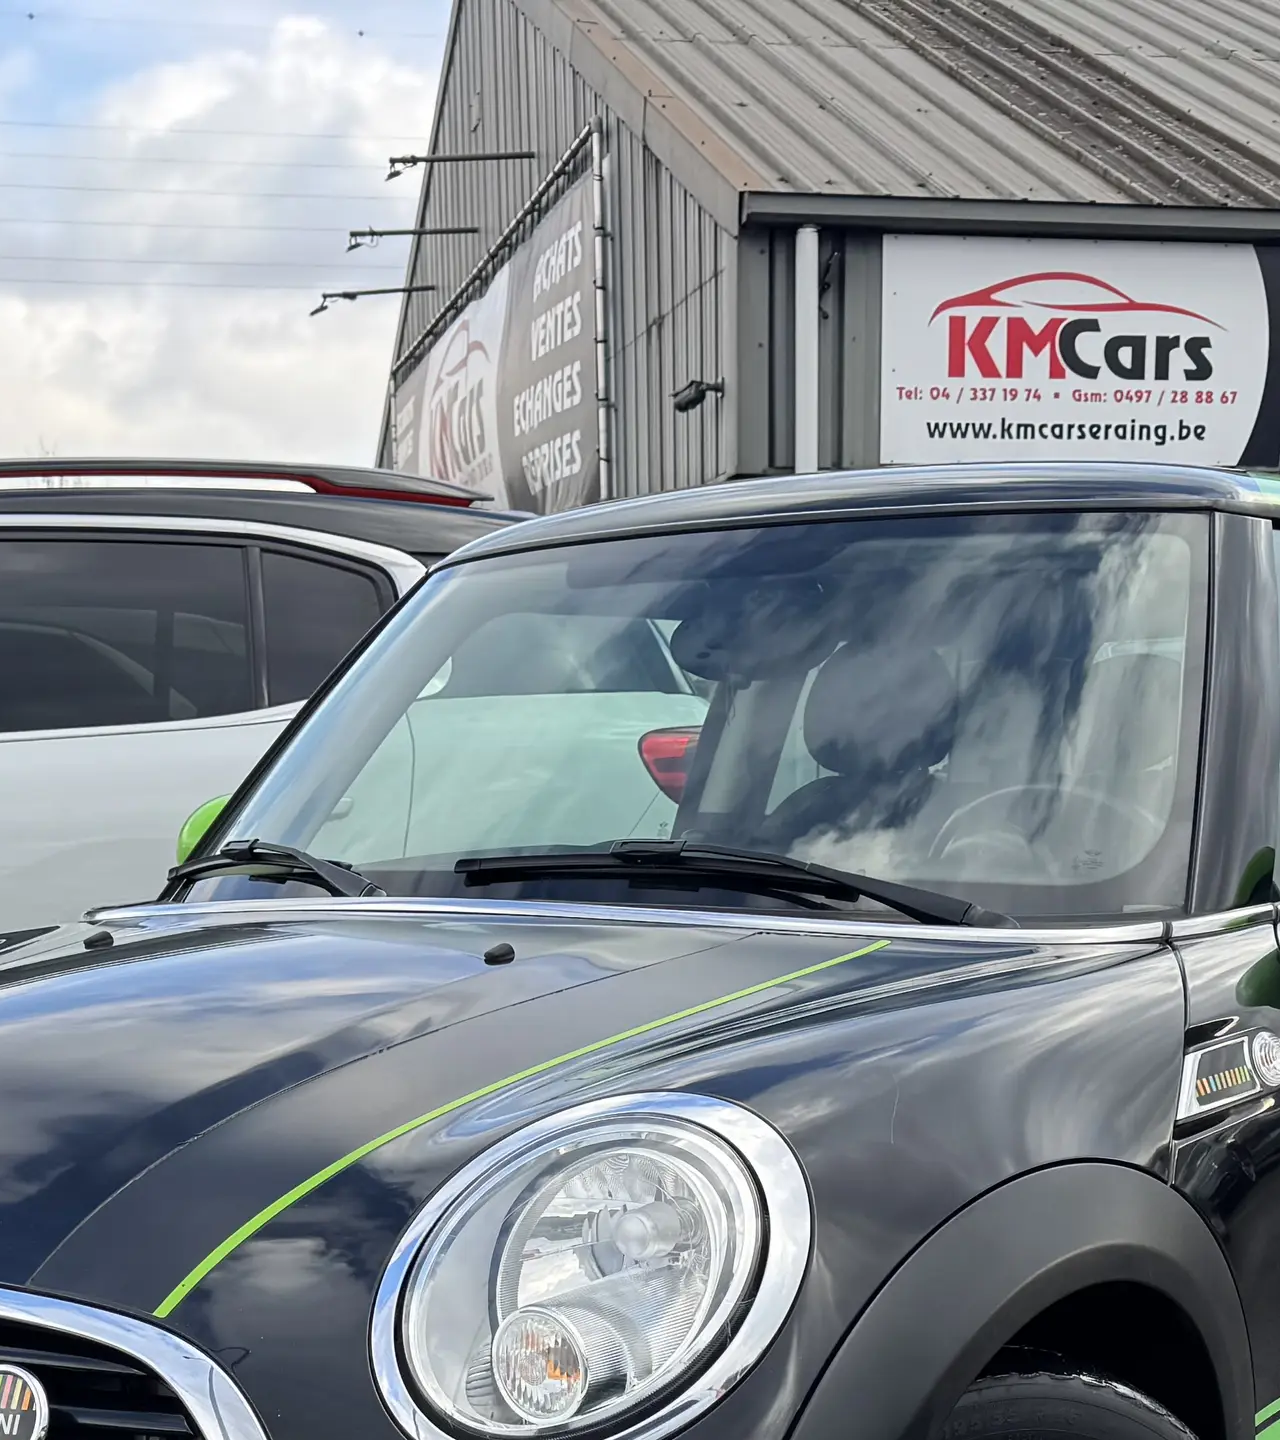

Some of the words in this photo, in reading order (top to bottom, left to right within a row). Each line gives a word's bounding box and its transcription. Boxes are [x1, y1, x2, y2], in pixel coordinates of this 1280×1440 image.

[530, 290, 581, 362] VENTES
[947, 315, 1214, 382] KMCars
[513, 360, 581, 437] ECHANGES
[896, 386, 923, 401] Tel:
[929, 386, 951, 401] 04
[969, 387, 996, 402] 337
[1003, 387, 1019, 402] 19
[1024, 388, 1042, 402] 74
[1071, 389, 1107, 403] Gsm:
[1113, 389, 1152, 404] 0497
[1170, 390, 1189, 404] 28
[1194, 390, 1214, 404] 88
[1220, 391, 1238, 405] 67
[926, 417, 1207, 446] www.kmcarseraing.be
